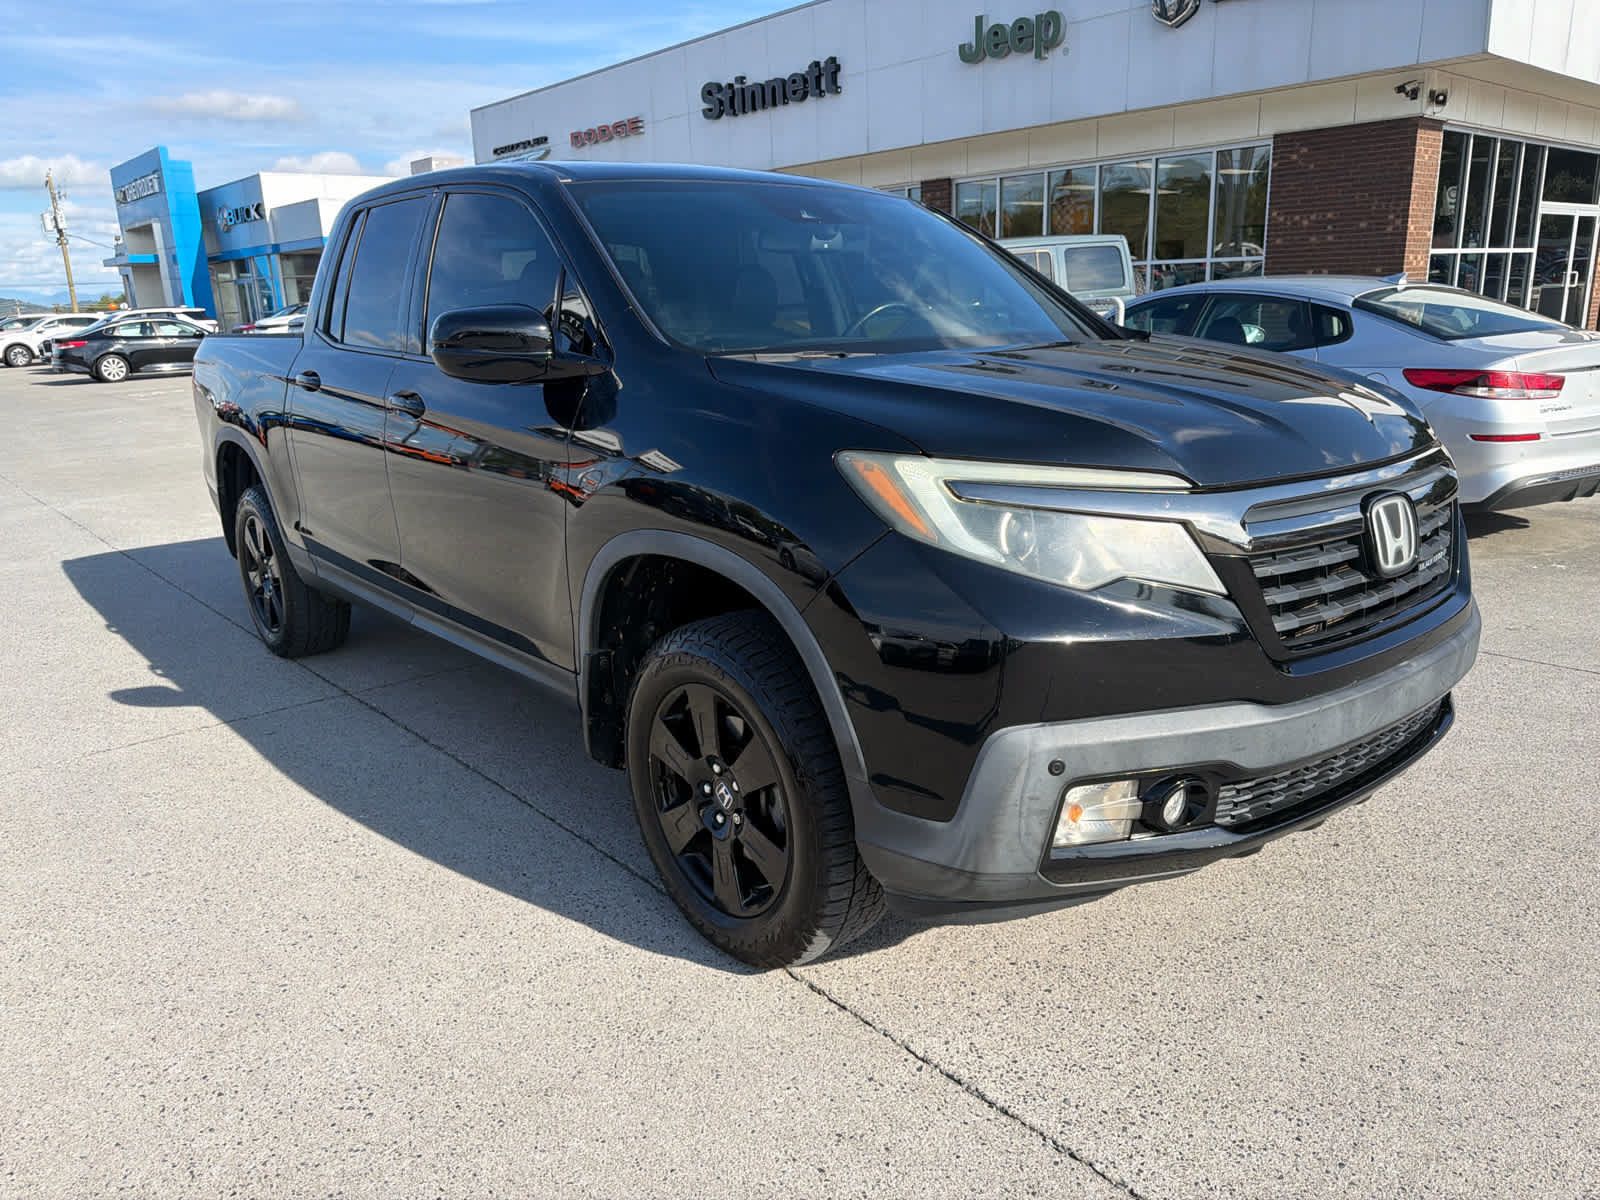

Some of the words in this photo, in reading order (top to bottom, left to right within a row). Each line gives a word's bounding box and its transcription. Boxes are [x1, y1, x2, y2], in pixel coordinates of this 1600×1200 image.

[959, 10, 1065, 65] Jeep
[701, 56, 842, 121] Stinnett
[570, 115, 645, 149] DODGE
[226, 203, 263, 226] BUICK
